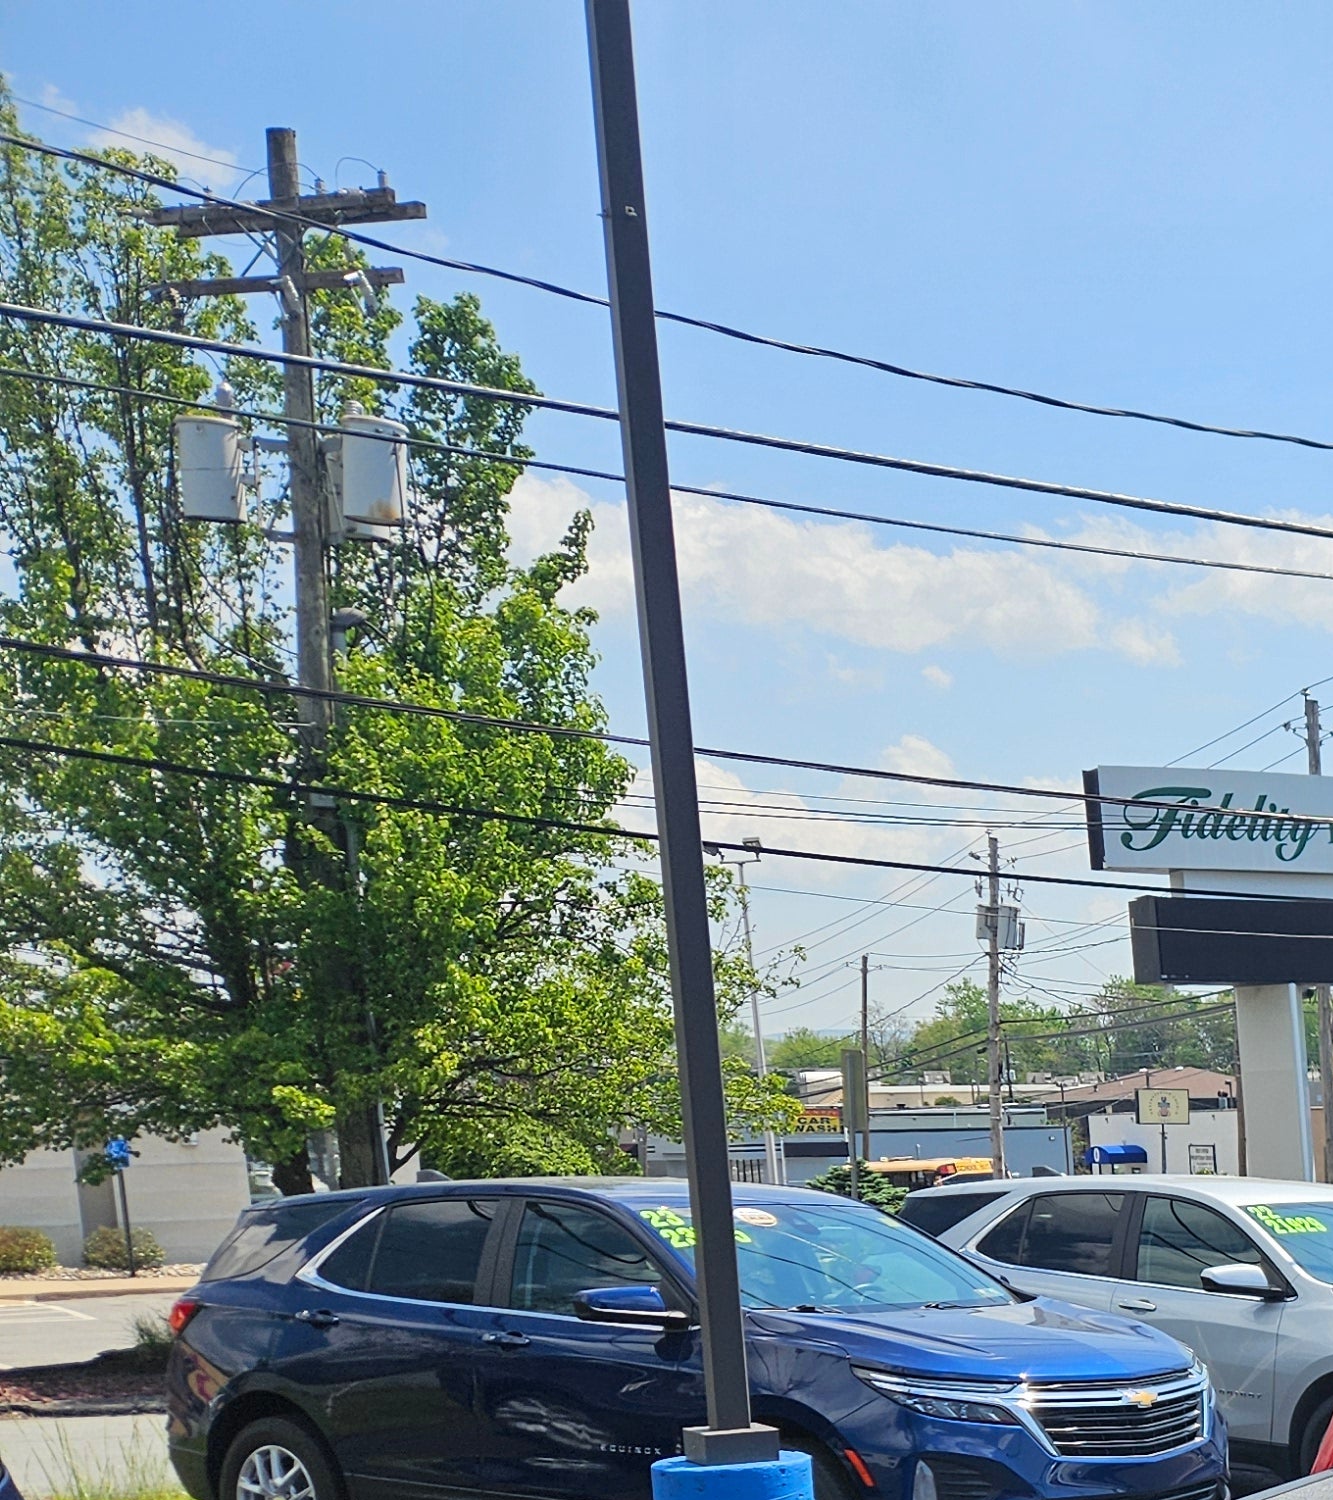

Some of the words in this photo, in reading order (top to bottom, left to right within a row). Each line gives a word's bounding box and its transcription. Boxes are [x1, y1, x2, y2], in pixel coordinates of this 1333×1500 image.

[1120, 786, 1320, 862] Fidelity
[797, 1116, 831, 1125] CAR
[639, 1207, 685, 1228] 23
[1246, 1204, 1281, 1220] 22
